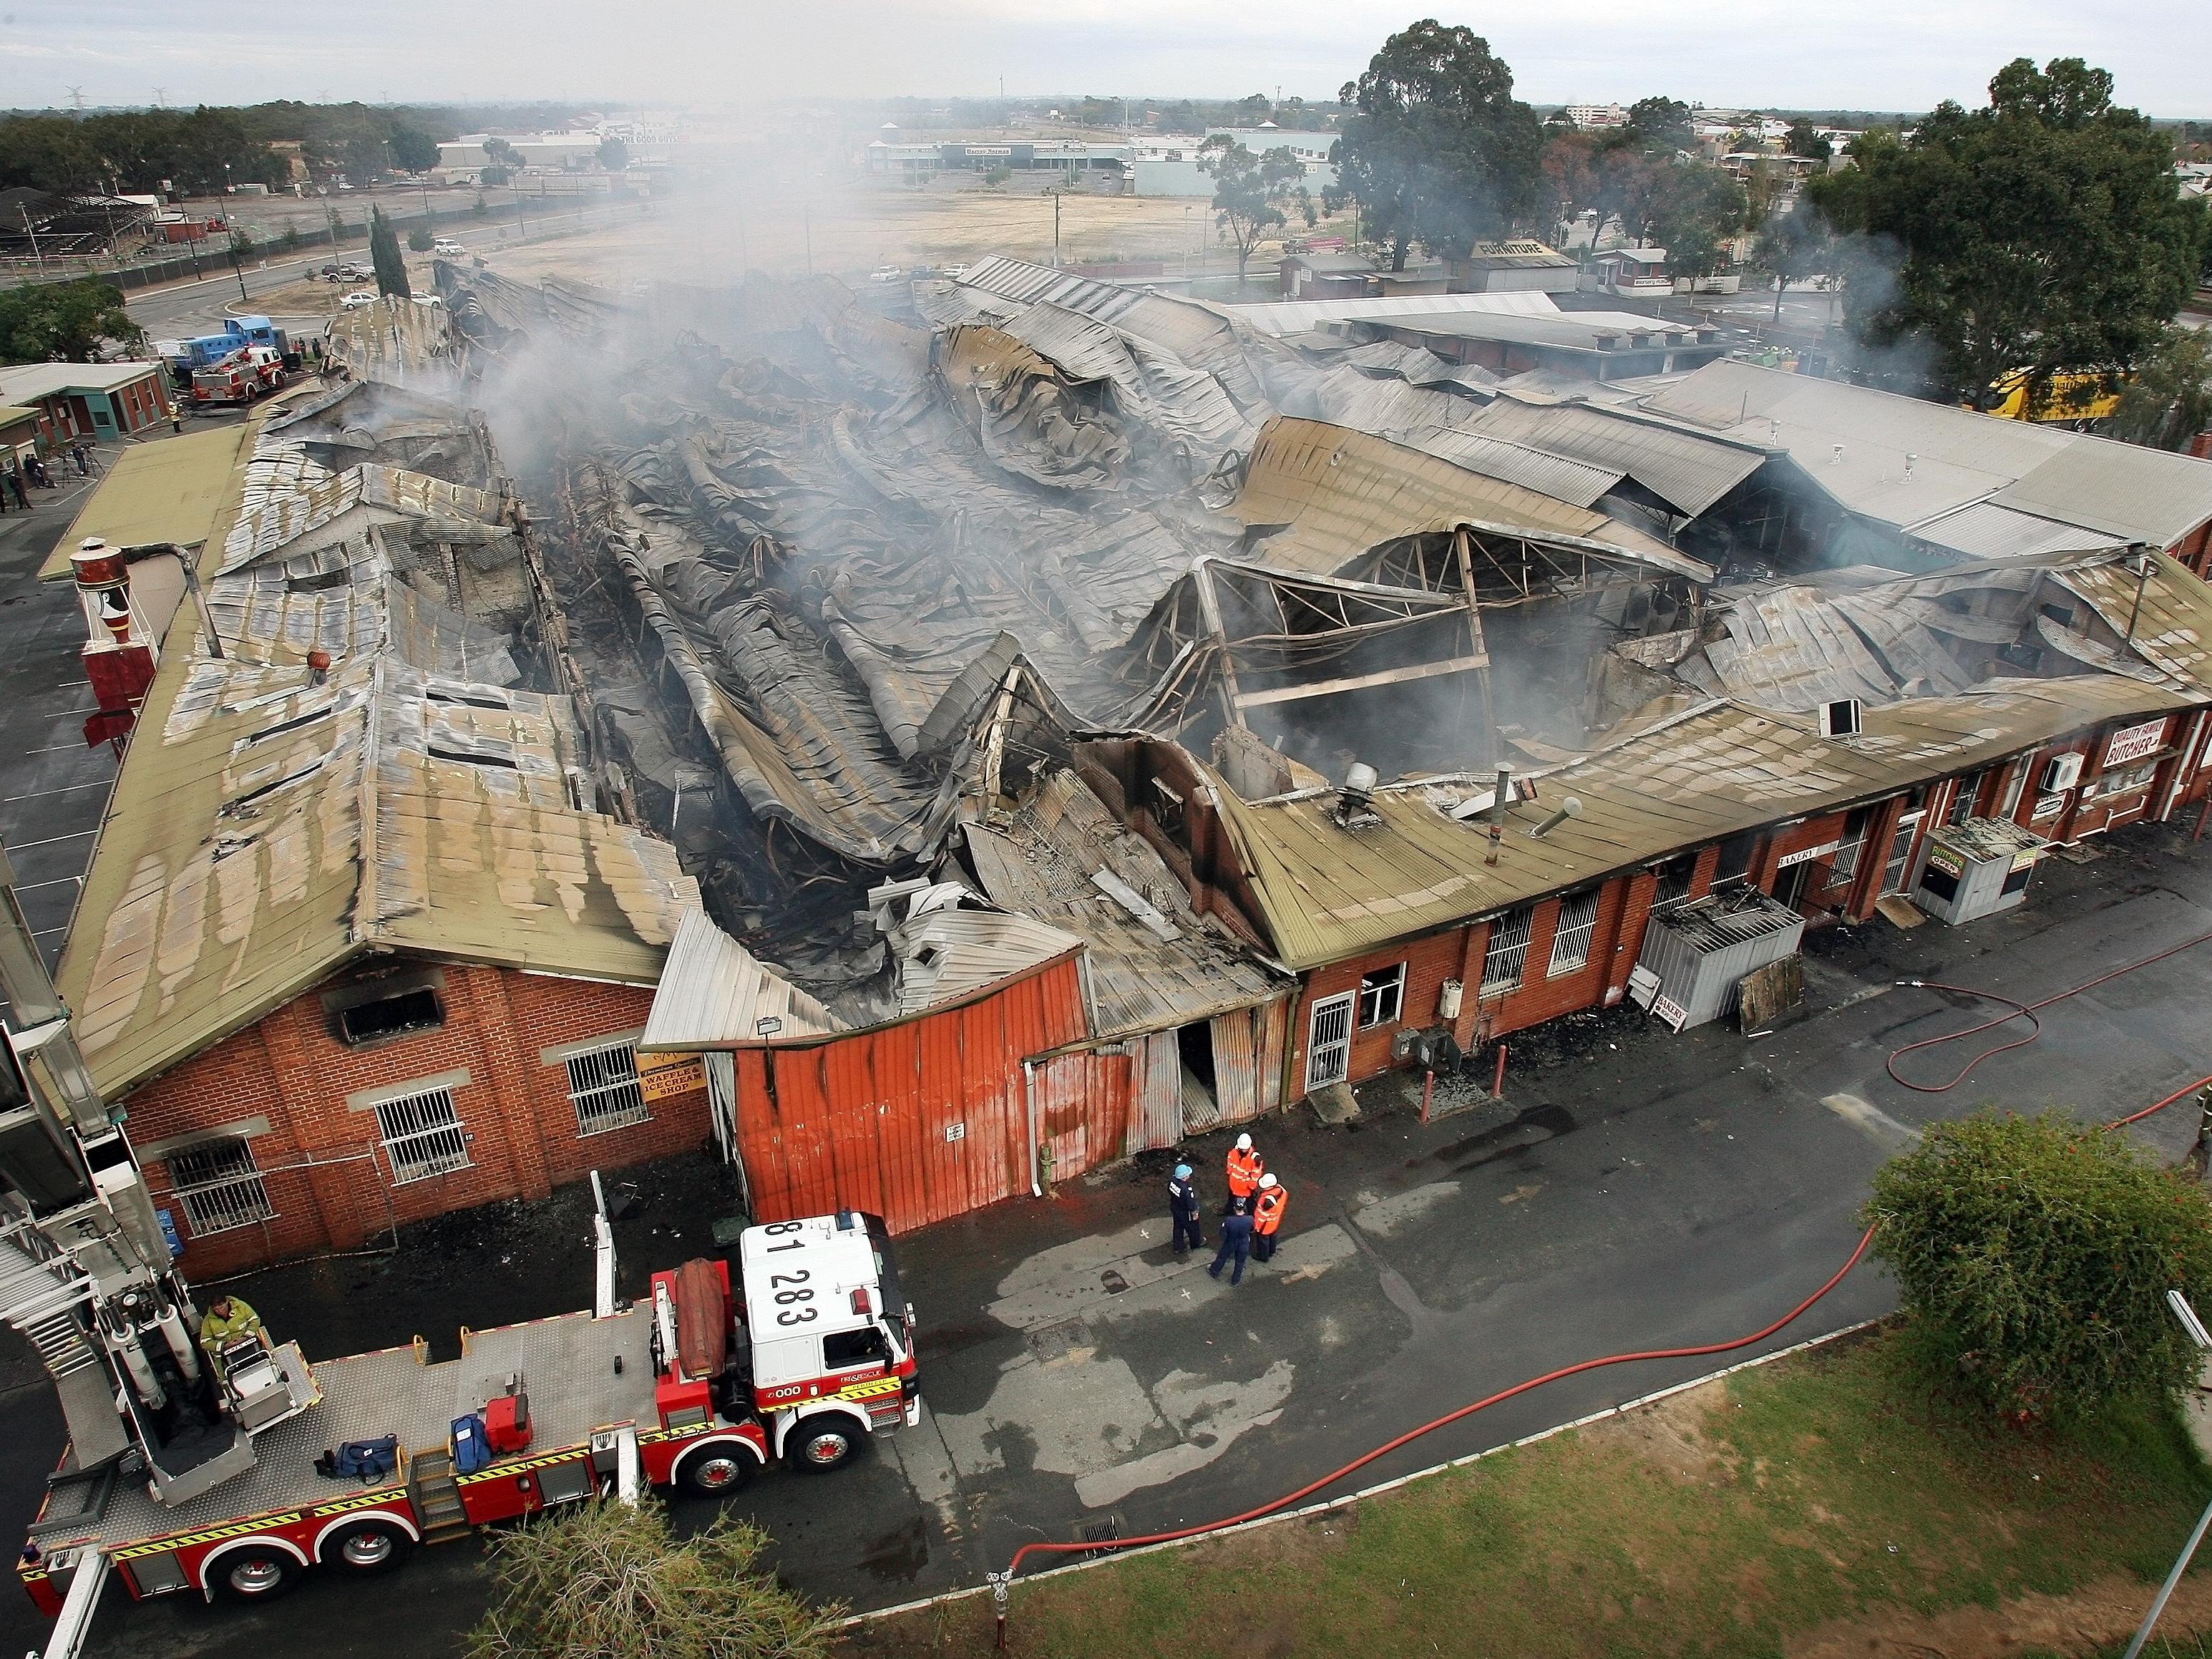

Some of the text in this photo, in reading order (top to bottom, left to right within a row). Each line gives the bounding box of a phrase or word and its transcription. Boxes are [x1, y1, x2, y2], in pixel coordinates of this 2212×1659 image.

[1479, 240, 1543, 254] FURNITURE
[2113, 726, 2145, 744] QUALITY
[2106, 736, 2153, 764] BUTCHER
[1778, 850, 1814, 867] BAKERY
[1932, 845, 1963, 870] BUTCHER
[1933, 857, 1957, 872] OPEN
[1657, 996, 1685, 1019] BAKERY
[645, 1073, 701, 1092] ICE CREAM
[646, 1069, 691, 1084] WAFFLE
[660, 1083, 689, 1095] SHOP
[771, 1270, 819, 1326] 283
[775, 1386, 801, 1398] 000
